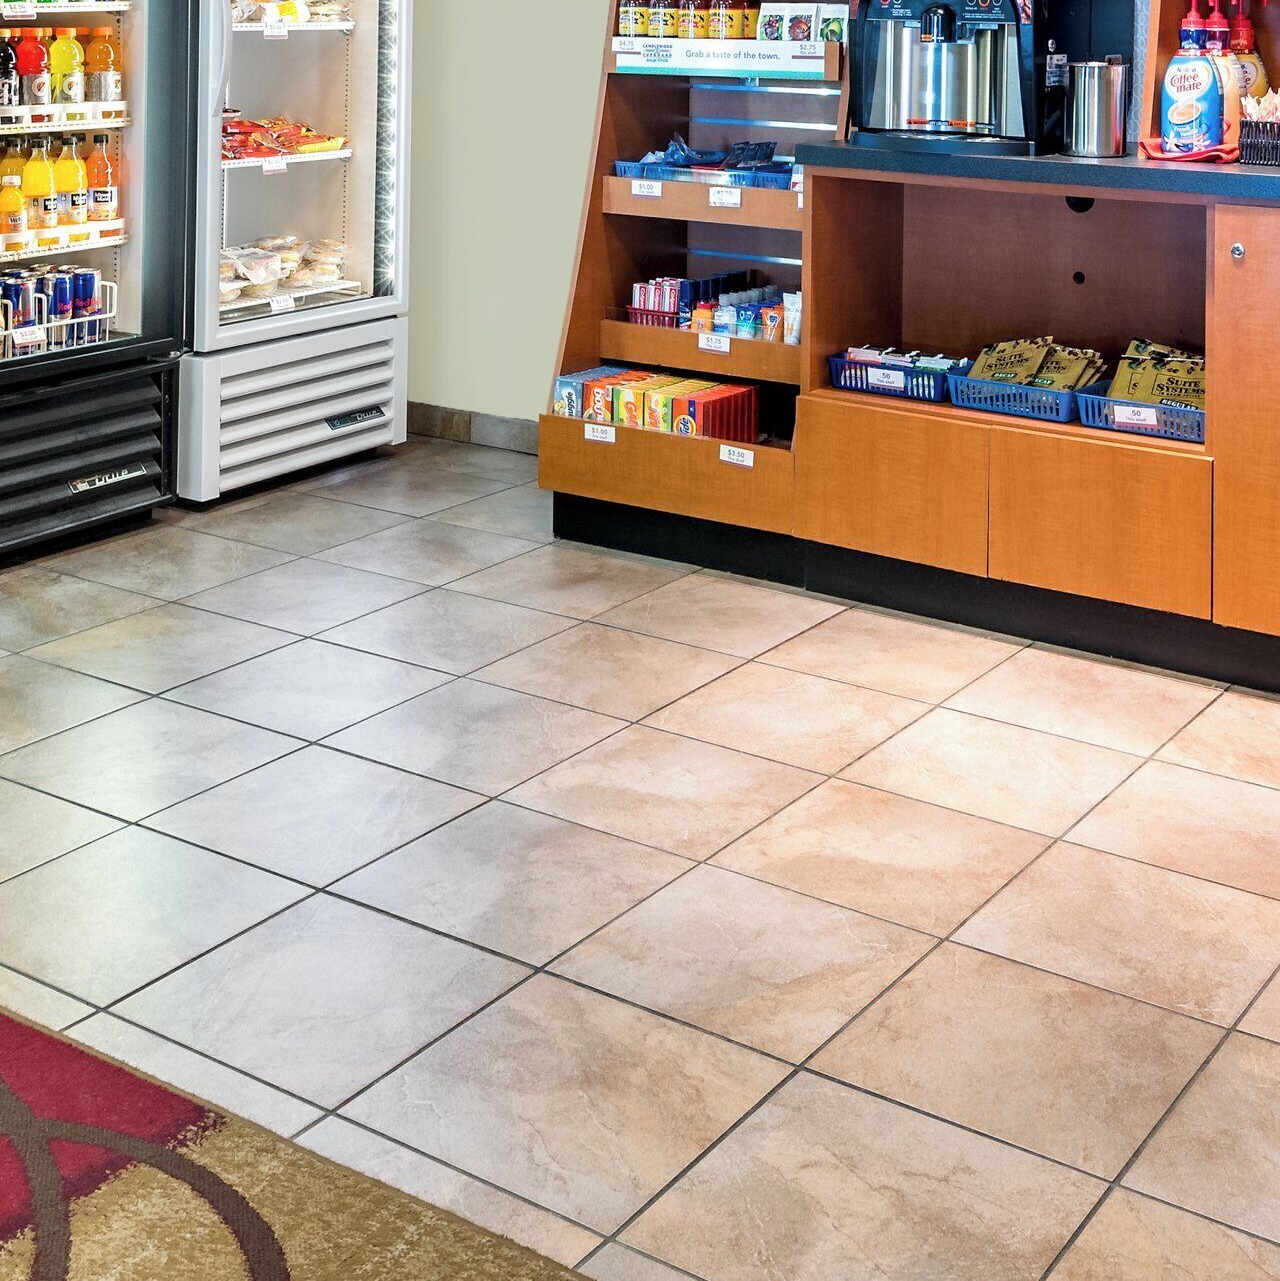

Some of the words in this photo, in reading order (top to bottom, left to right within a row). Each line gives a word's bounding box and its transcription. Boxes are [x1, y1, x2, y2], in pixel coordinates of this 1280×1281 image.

[685, 50, 703, 59] Grab
[733, 50, 741, 59] of
[743, 50, 756, 59] the
[758, 52, 781, 60] town.
[1169, 72, 1199, 87] Coffee
[1176, 80, 1202, 93] mate
[995, 353, 1018, 364] SUITE
[984, 358, 1029, 372] SYSTEMS
[1167, 378, 1200, 388] SUITE
[1131, 409, 1141, 417] 50
[728, 450, 745, 459] $3.50
